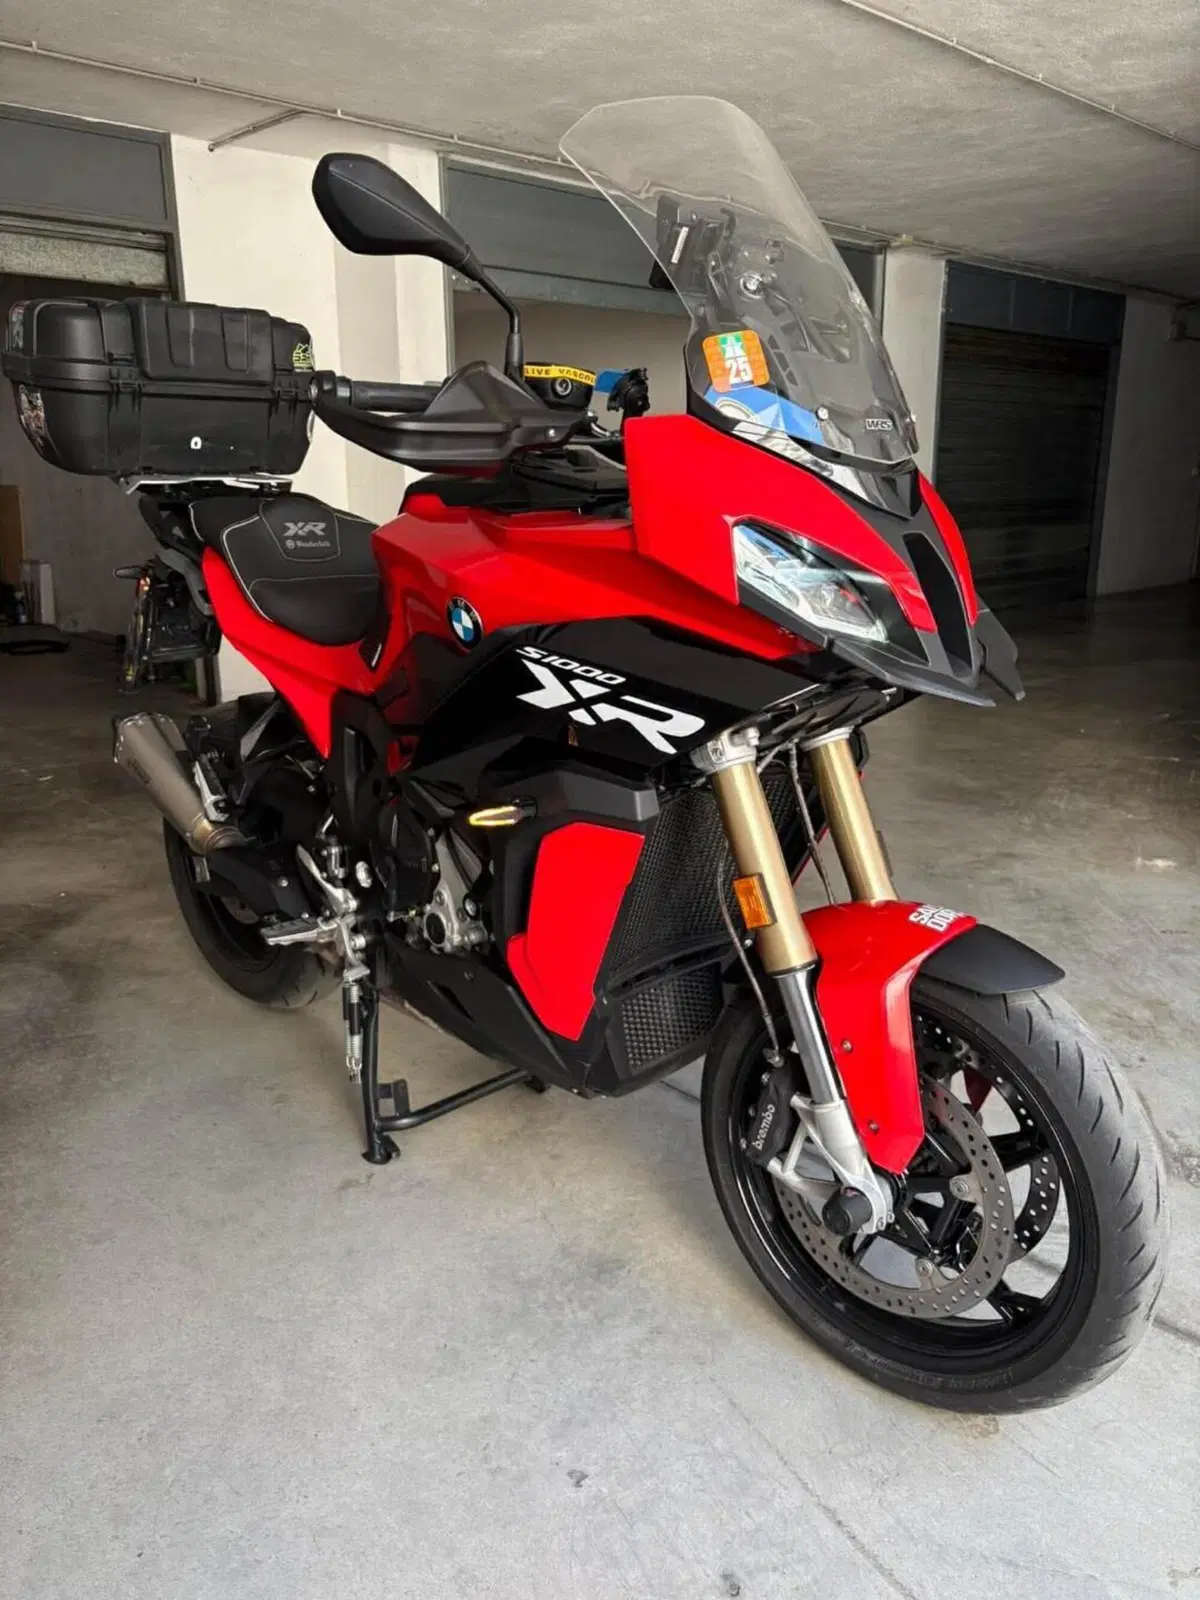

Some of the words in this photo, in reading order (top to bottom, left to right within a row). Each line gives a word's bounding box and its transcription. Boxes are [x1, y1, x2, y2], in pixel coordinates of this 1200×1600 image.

[724, 357, 753, 384] 25
[866, 418, 892, 430] WRS
[282, 521, 326, 537] XR
[516, 646, 627, 685] S1000
[516, 659, 706, 755] XR
[751, 1103, 776, 1152] brembo
